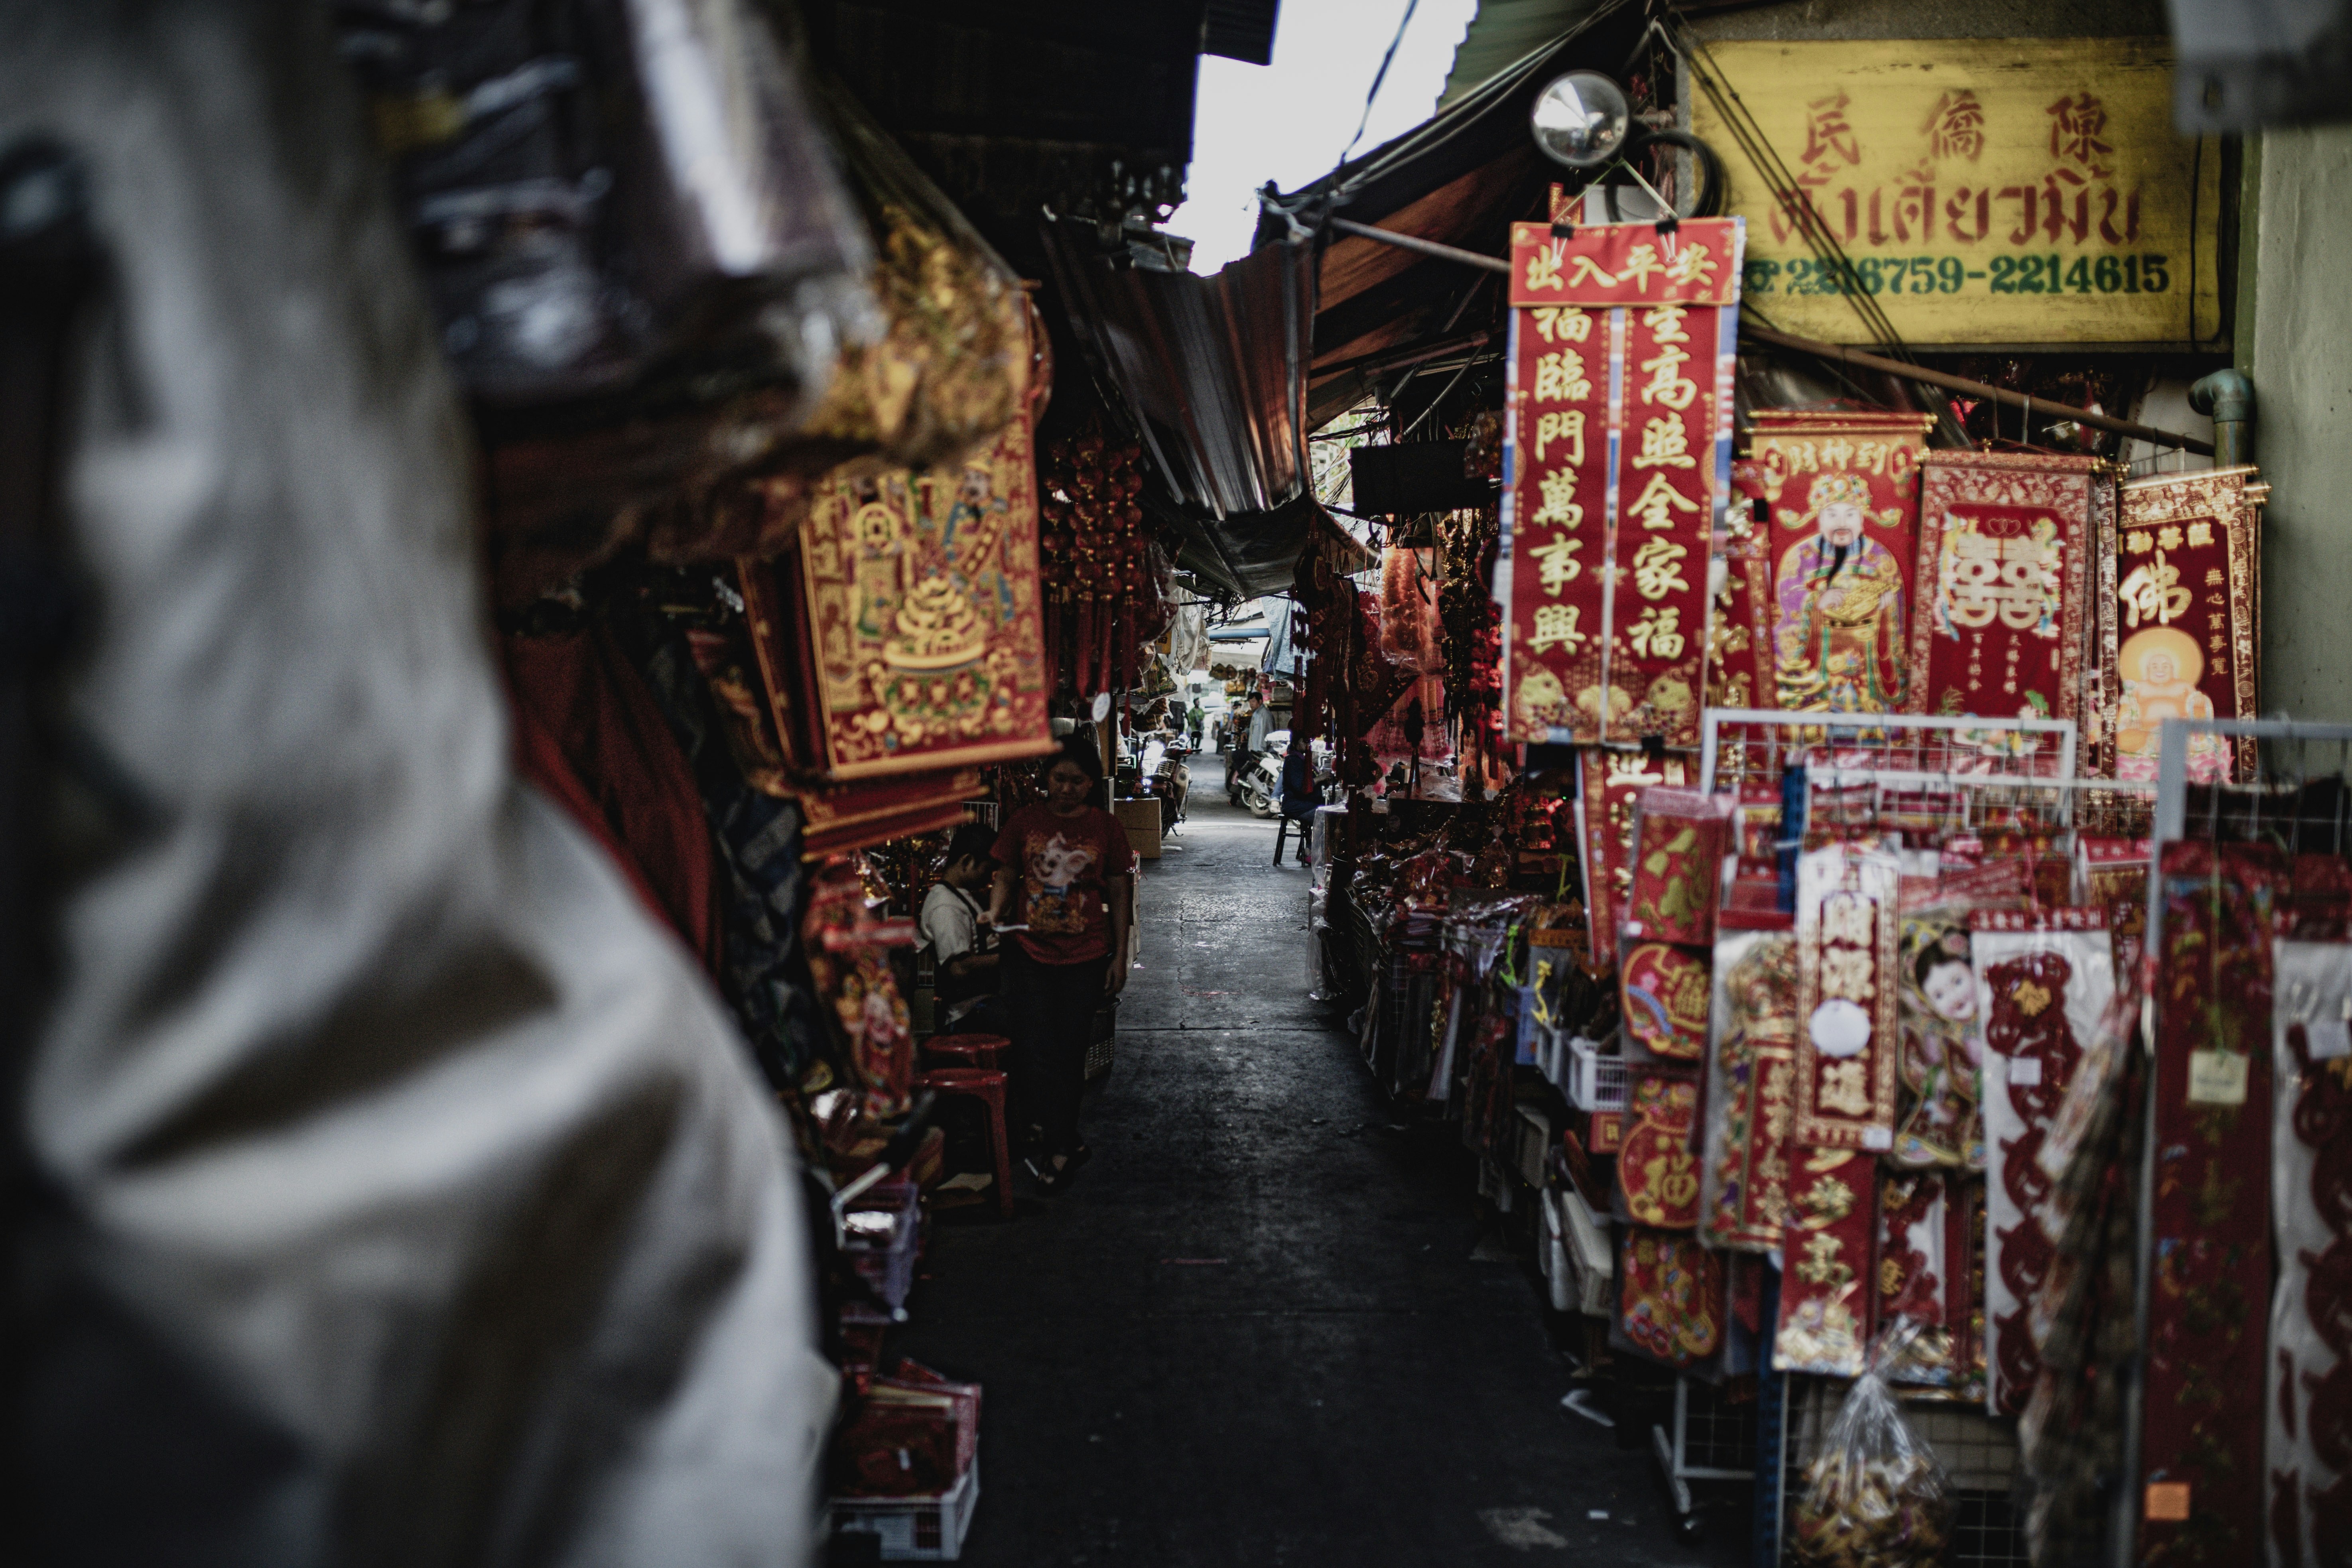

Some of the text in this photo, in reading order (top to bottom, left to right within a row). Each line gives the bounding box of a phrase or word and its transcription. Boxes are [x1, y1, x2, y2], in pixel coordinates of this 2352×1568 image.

[1525, 241, 1718, 294] 出入平安
[2118, 550, 2192, 627] 佛
